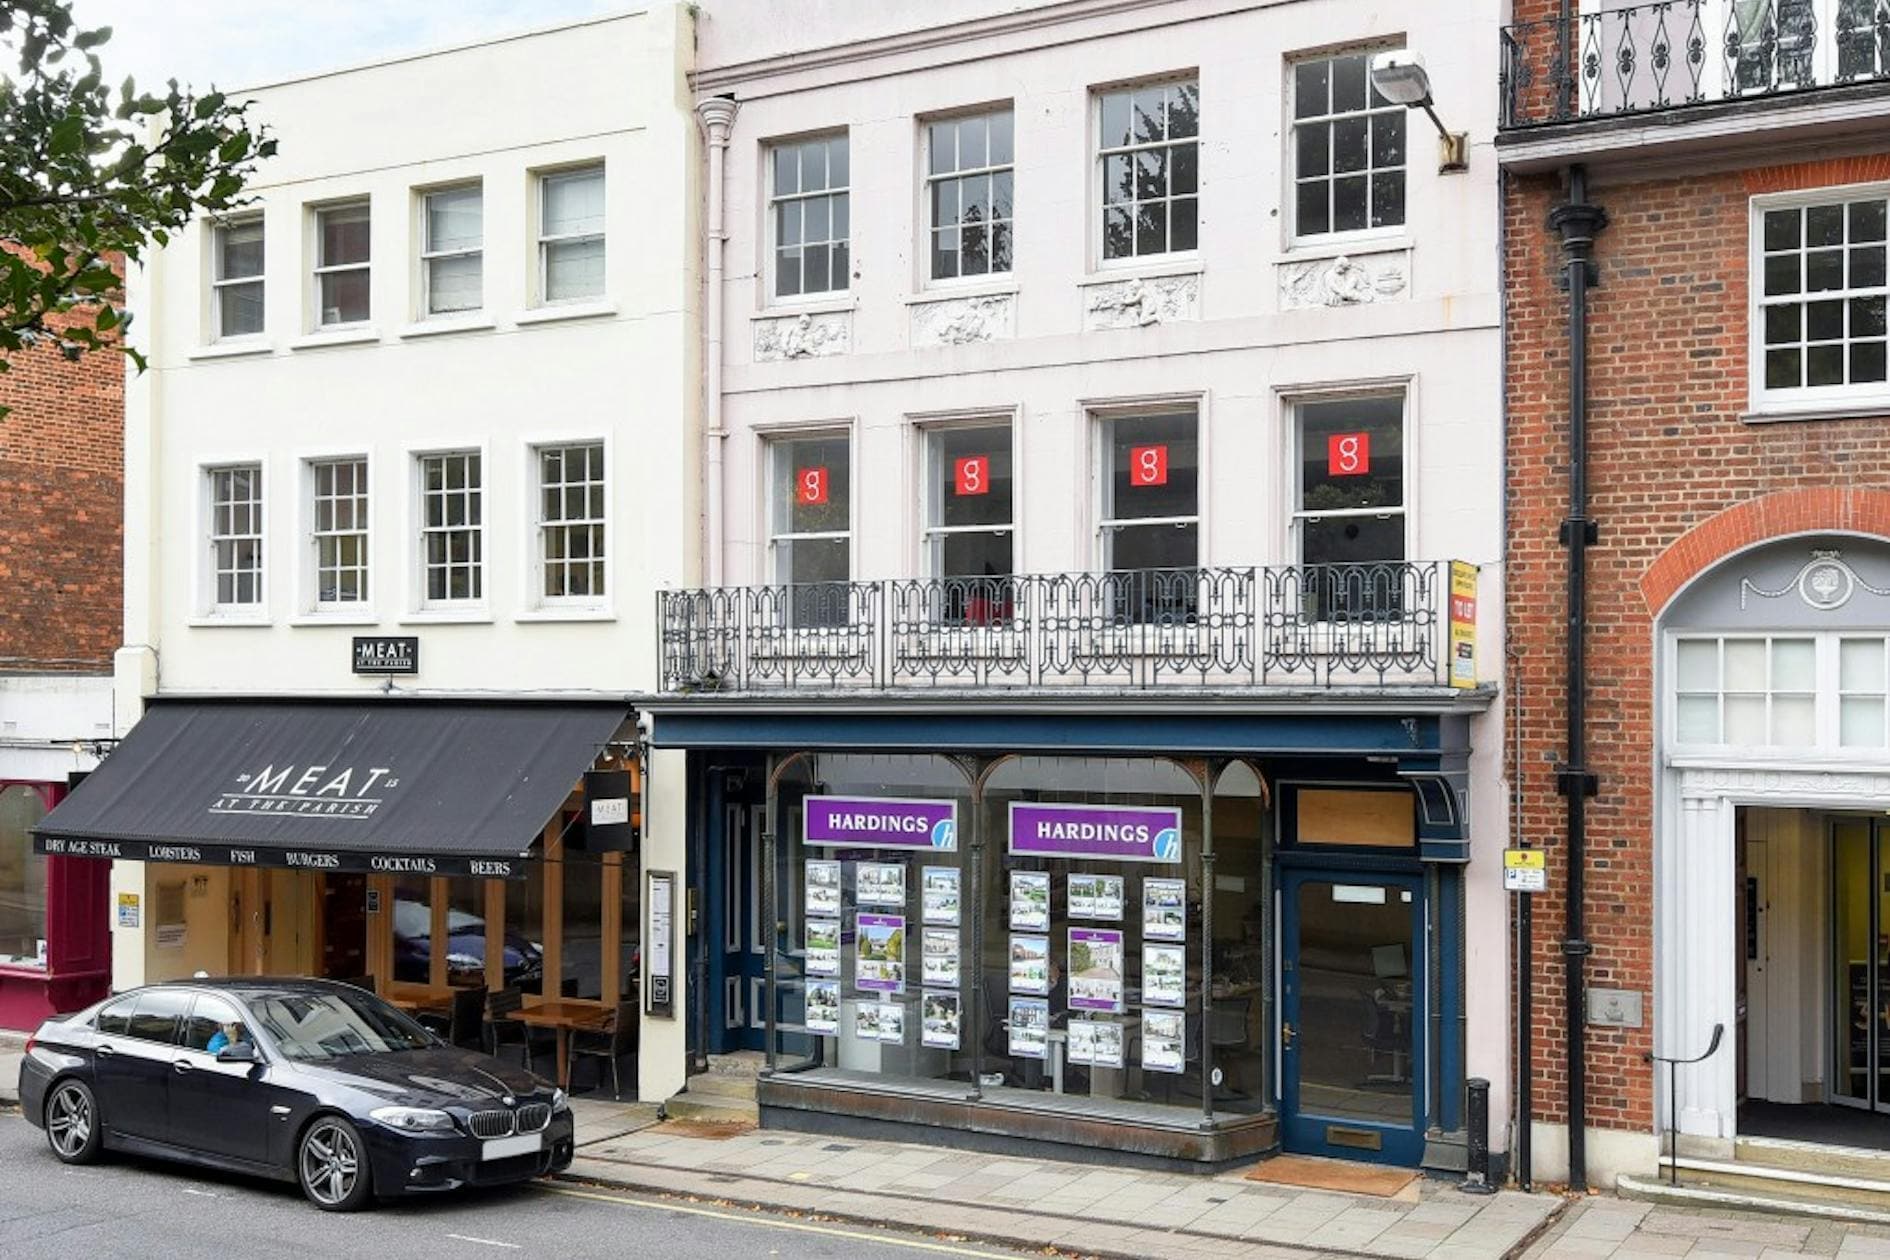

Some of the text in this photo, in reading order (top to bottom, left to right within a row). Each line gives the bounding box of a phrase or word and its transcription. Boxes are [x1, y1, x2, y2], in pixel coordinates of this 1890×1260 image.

[362, 642, 406, 658] MEAT
[243, 764, 390, 797] MEAT
[212, 799, 380, 815] AT THE PARISH
[828, 813, 929, 833] HARDINGS
[1037, 821, 1149, 843] HARDINGS
[45, 839, 121, 857] DRY AGE STEAK
[149, 845, 201, 861] LOBSTERS
[230, 849, 255, 864] FISH
[286, 852, 340, 868] BURGERS
[371, 855, 436, 873] COCKTAILS
[470, 859, 512, 876] BEERS
